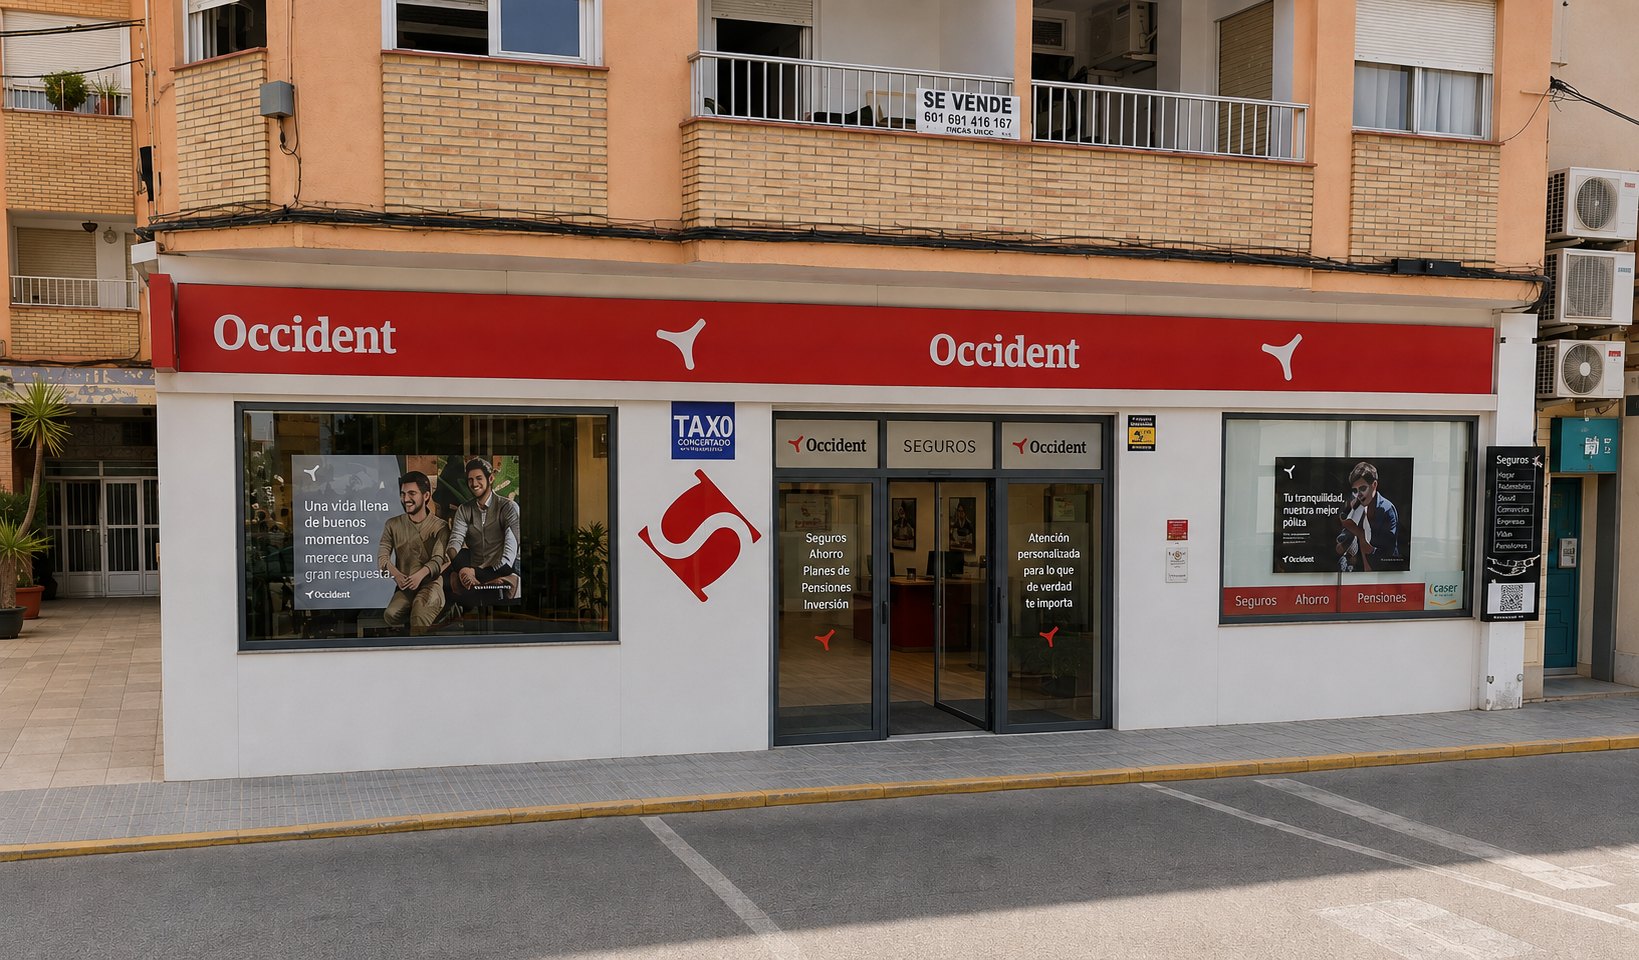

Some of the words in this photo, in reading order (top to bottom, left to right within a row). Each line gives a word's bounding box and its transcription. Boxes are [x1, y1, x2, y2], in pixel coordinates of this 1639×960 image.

[923, 91, 946, 109] SE
[952, 93, 1012, 114] VENDE
[924, 111, 943, 123] 601
[970, 115, 990, 128] 416
[994, 117, 1012, 129] 167
[213, 314, 397, 354] Occident
[929, 333, 1080, 369] Occident
[806, 438, 867, 452] Occident
[903, 440, 976, 453] SEGUROS
[1029, 439, 1087, 454] Occident
[1496, 455, 1529, 467] Seguros
[1284, 493, 1293, 503] Tu
[304, 500, 328, 511] Una
[331, 499, 356, 511] vida
[360, 500, 389, 511] llena
[1283, 507, 1314, 515] nuestra
[1315, 505, 1339, 517] mejor
[304, 516, 319, 527] de
[323, 516, 366, 527] buenos
[304, 533, 370, 545] momentos
[805, 532, 847, 546] Seguros
[1028, 532, 1070, 543] Atención
[304, 553, 349, 563] merece
[351, 553, 373, 563] una
[809, 549, 843, 559] Ahorro
[305, 570, 330, 583] gran
[803, 565, 836, 576] Planes
[837, 565, 850, 576] de
[1023, 566, 1044, 577] para
[1046, 565, 1055, 575] lo
[1056, 566, 1075, 577] que
[801, 582, 852, 593] Pensiones
[1026, 581, 1039, 592] de
[1040, 581, 1072, 592] verdad
[1433, 584, 1458, 593] caser
[314, 591, 351, 599] Occident
[1234, 596, 1278, 610] Seguros
[1295, 592, 1330, 606] Ahorro
[1357, 591, 1407, 605] Pensiones
[804, 599, 849, 610] Inversión
[1025, 598, 1035, 608] te
[1037, 598, 1073, 610] importa
